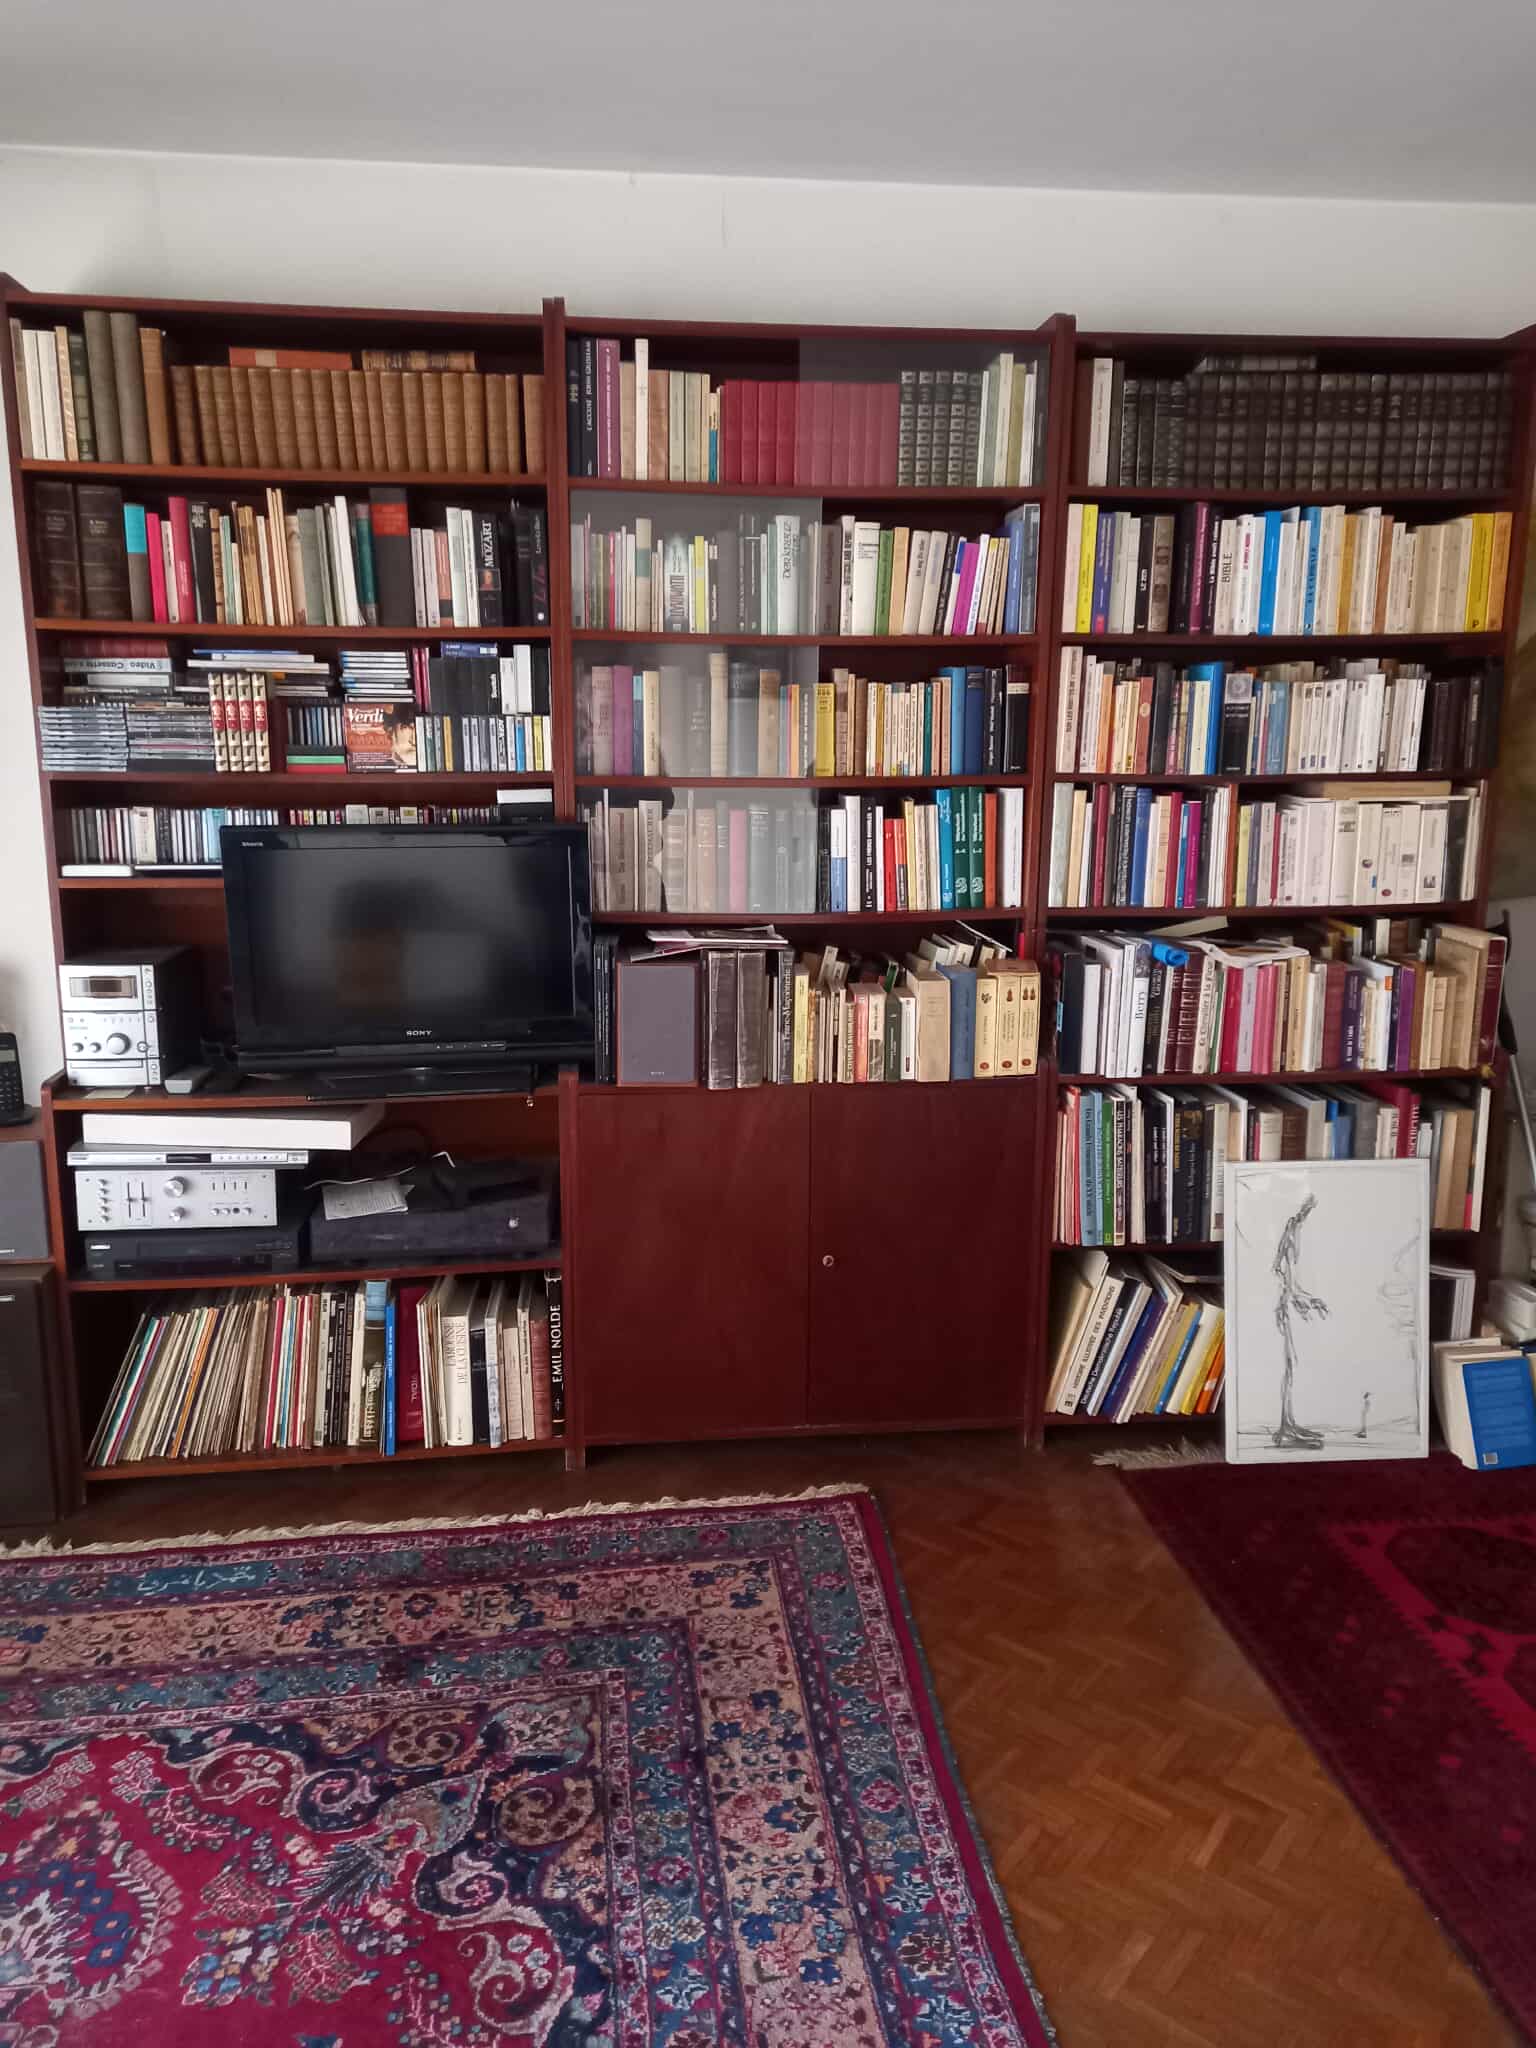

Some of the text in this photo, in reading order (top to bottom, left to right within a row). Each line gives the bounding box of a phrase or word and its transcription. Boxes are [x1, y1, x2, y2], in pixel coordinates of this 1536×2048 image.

[482, 520, 495, 568] MOZART
[1221, 552, 1232, 584] BIBLE
[130, 661, 156, 670] Video
[347, 708, 385, 724] Verdi
[1135, 991, 1145, 1019] Berry
[550, 1304, 563, 1383] EMIL NOLDE
